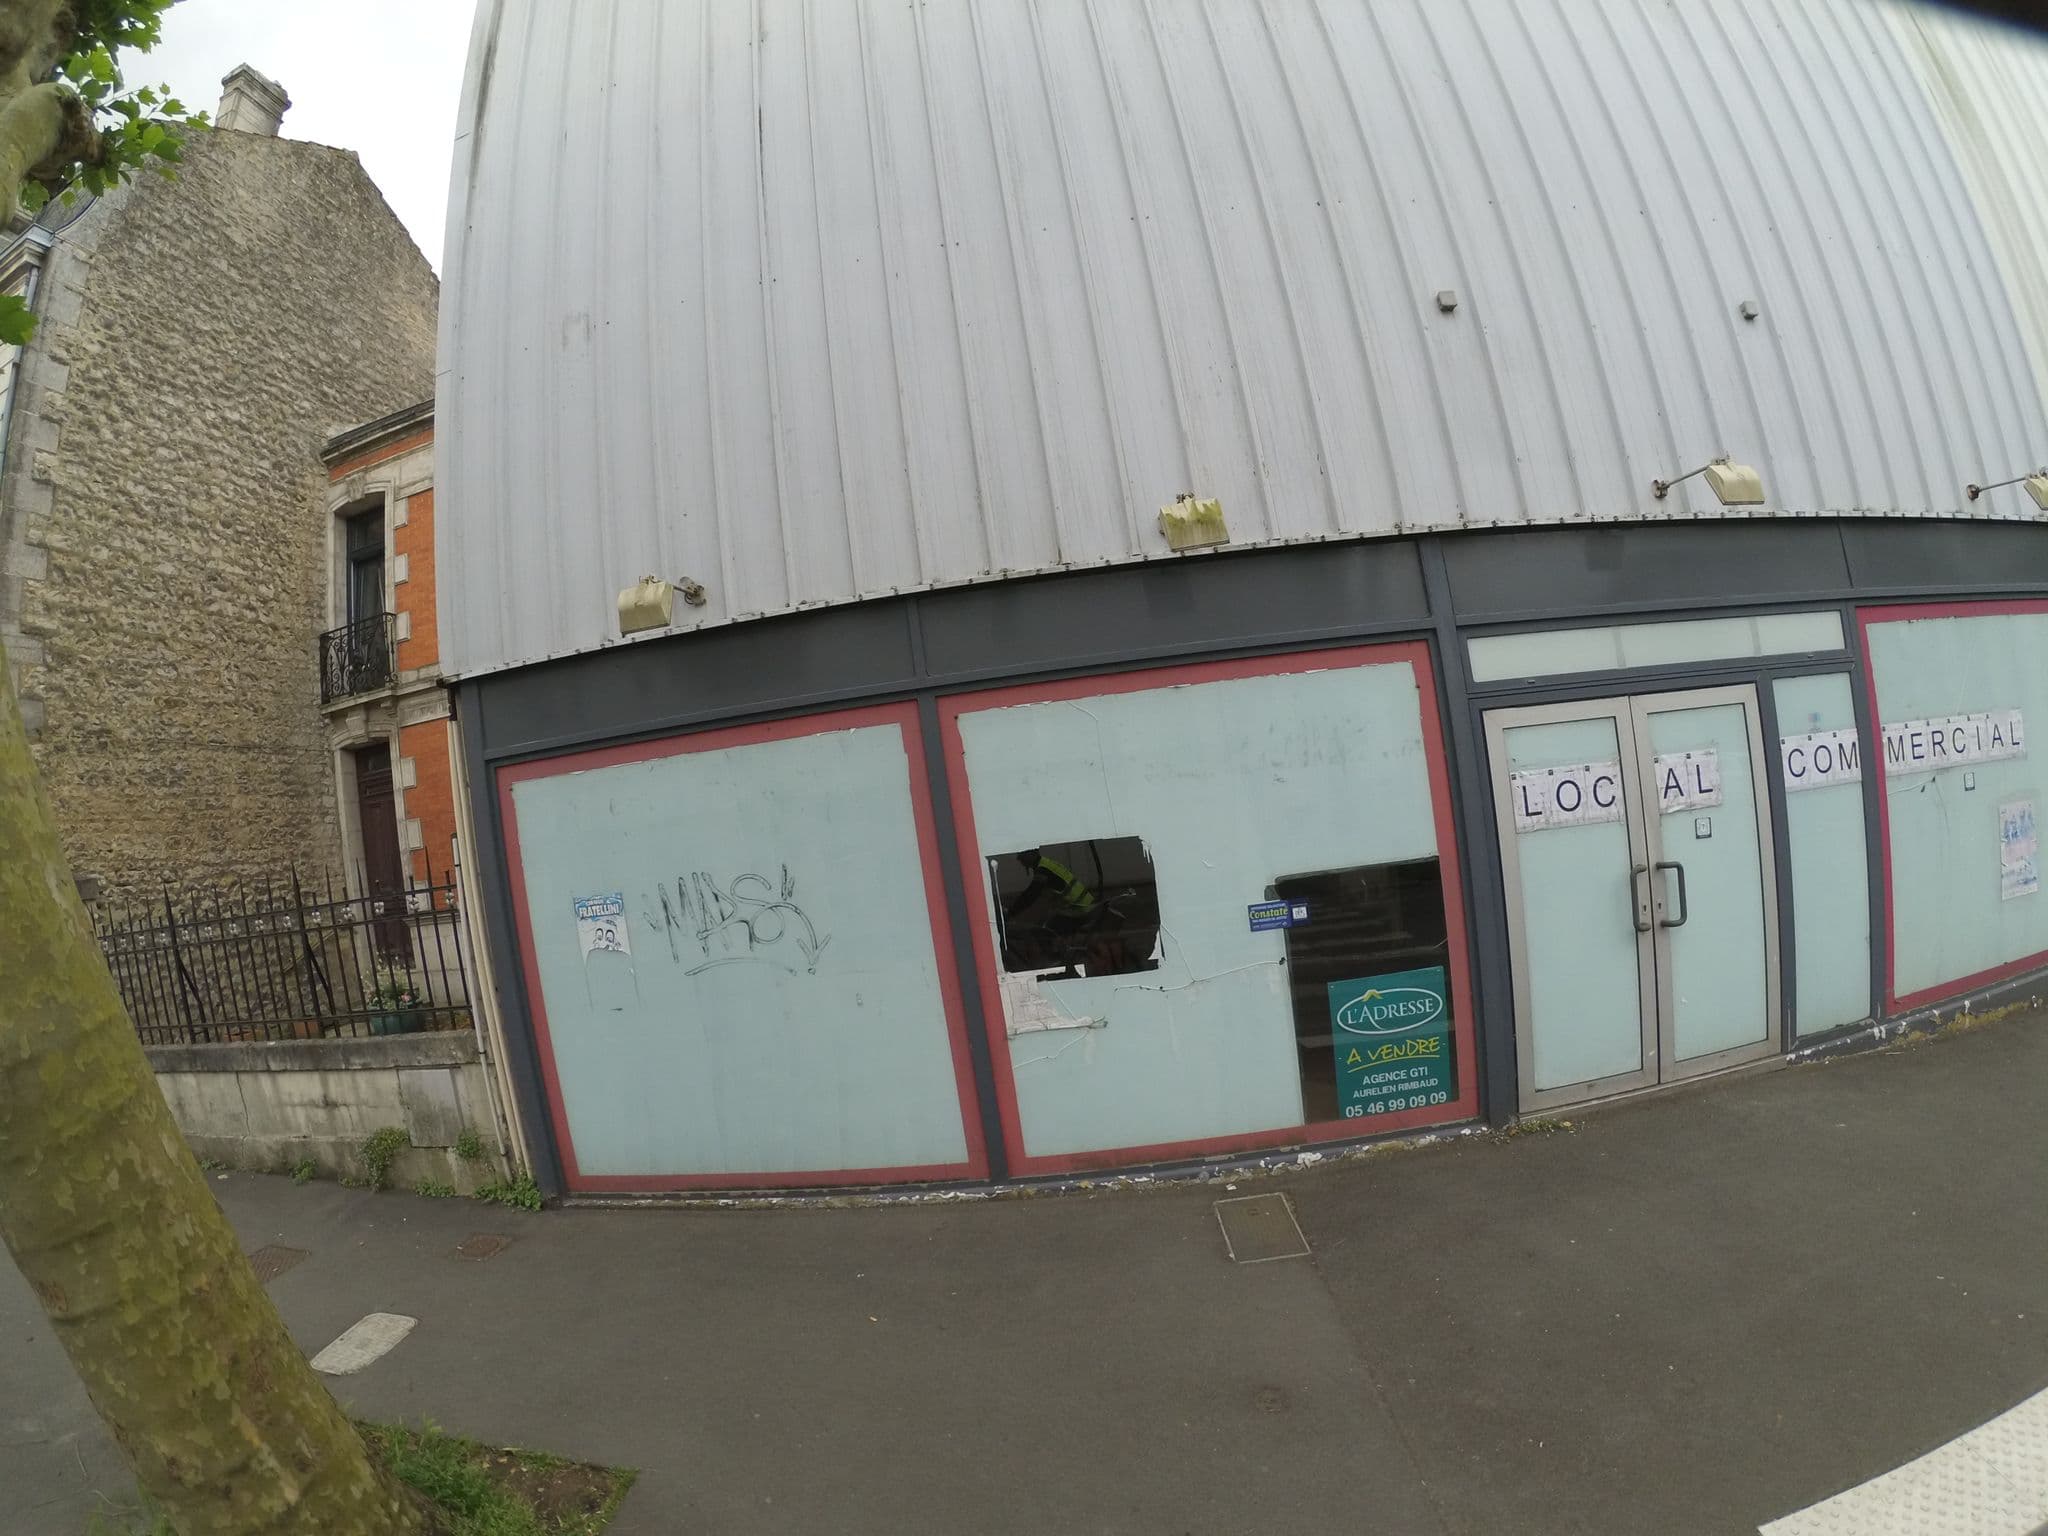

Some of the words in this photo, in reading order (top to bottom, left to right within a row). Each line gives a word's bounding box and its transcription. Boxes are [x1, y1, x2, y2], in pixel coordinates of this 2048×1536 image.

[578, 903, 620, 918] FRATELLINI
[1346, 998, 1434, 1030] L'ADRESSE
[1347, 1047, 1362, 1065] A
[1367, 1036, 1441, 1060] VENDRE
[1362, 1069, 1408, 1085] AGENCE
[1409, 1066, 1428, 1078] GTI
[1353, 1084, 1397, 1098] AURELIEN
[1398, 1078, 1439, 1091] RIMBAUD
[1345, 1104, 1363, 1118] 05
[1367, 1101, 1385, 1114] 46
[1388, 1098, 1406, 1111] 99
[1409, 1094, 1427, 1108] 09
[1430, 1091, 1447, 1105] 09
